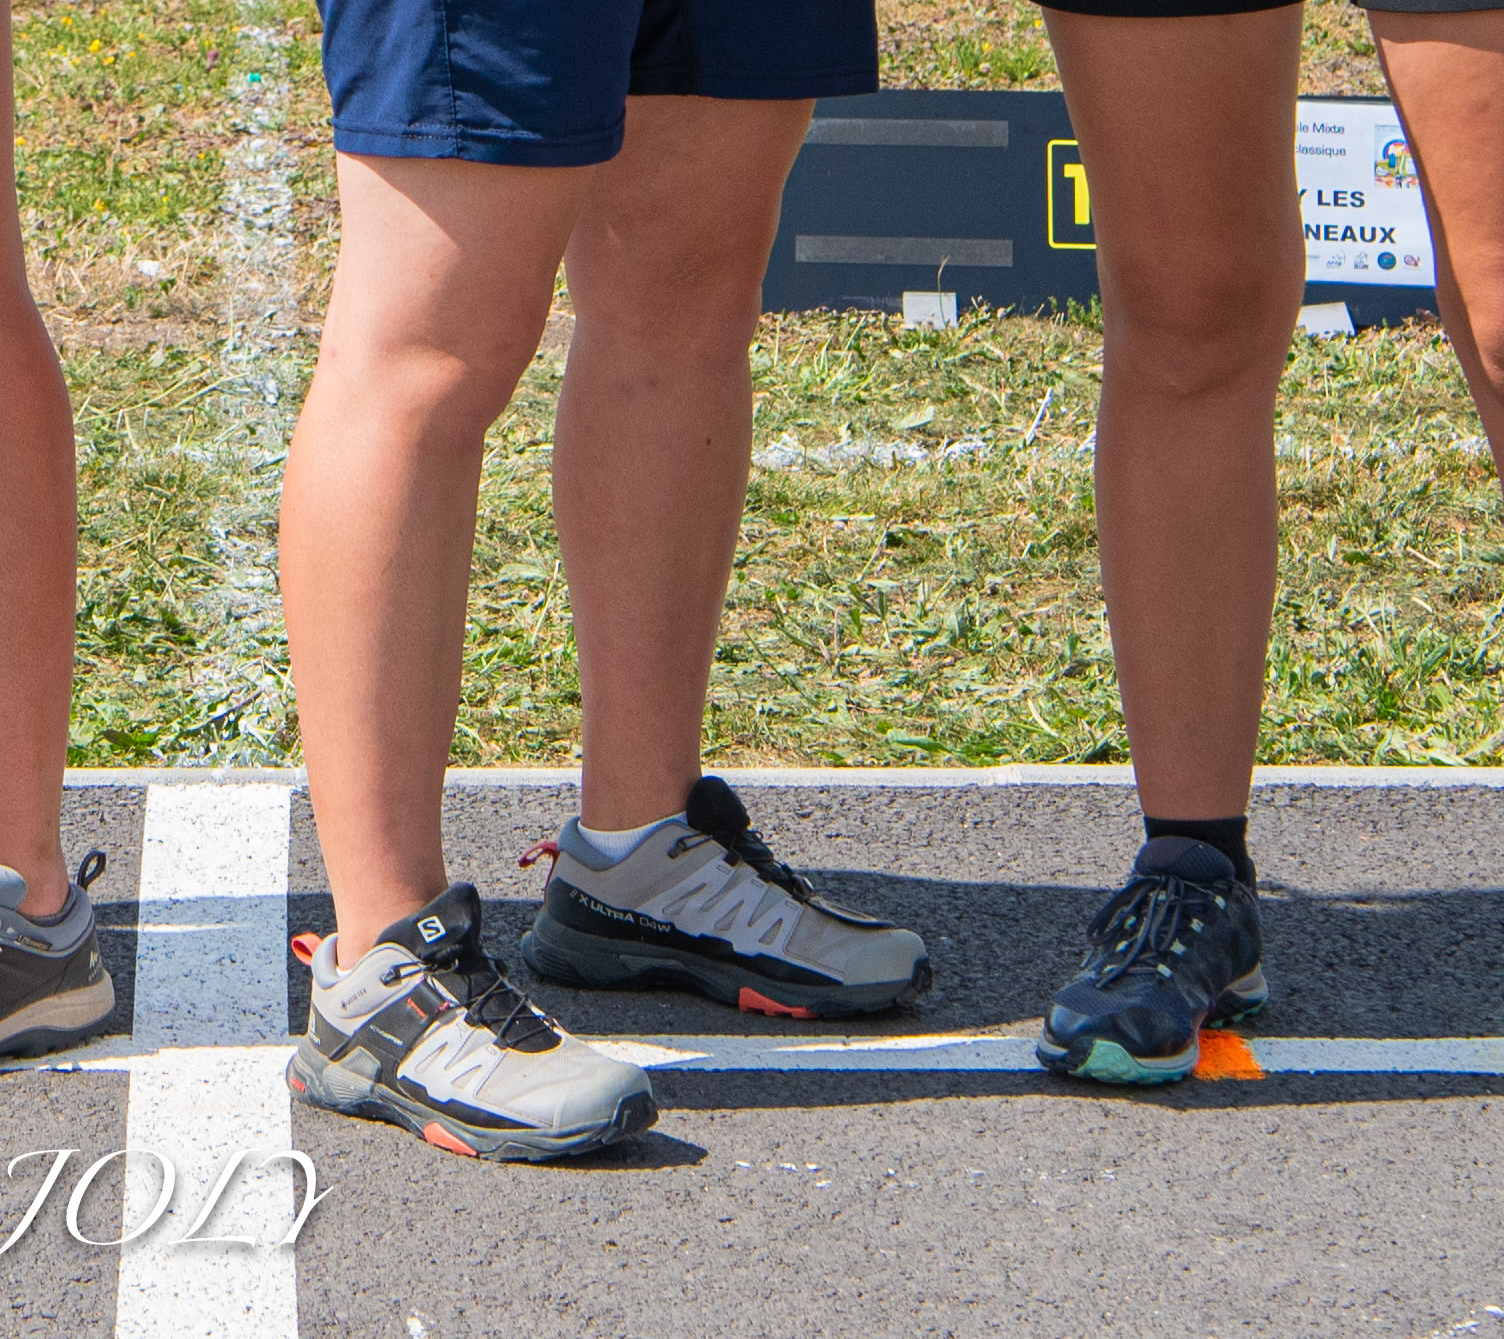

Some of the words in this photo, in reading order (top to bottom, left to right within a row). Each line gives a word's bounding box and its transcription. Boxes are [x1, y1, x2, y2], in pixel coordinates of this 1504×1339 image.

[1312, 123, 1344, 134] Mixte
[1317, 189, 1365, 208] LES
[1304, 223, 1396, 244] NEAUX
[590, 900, 635, 923] ULTRA
